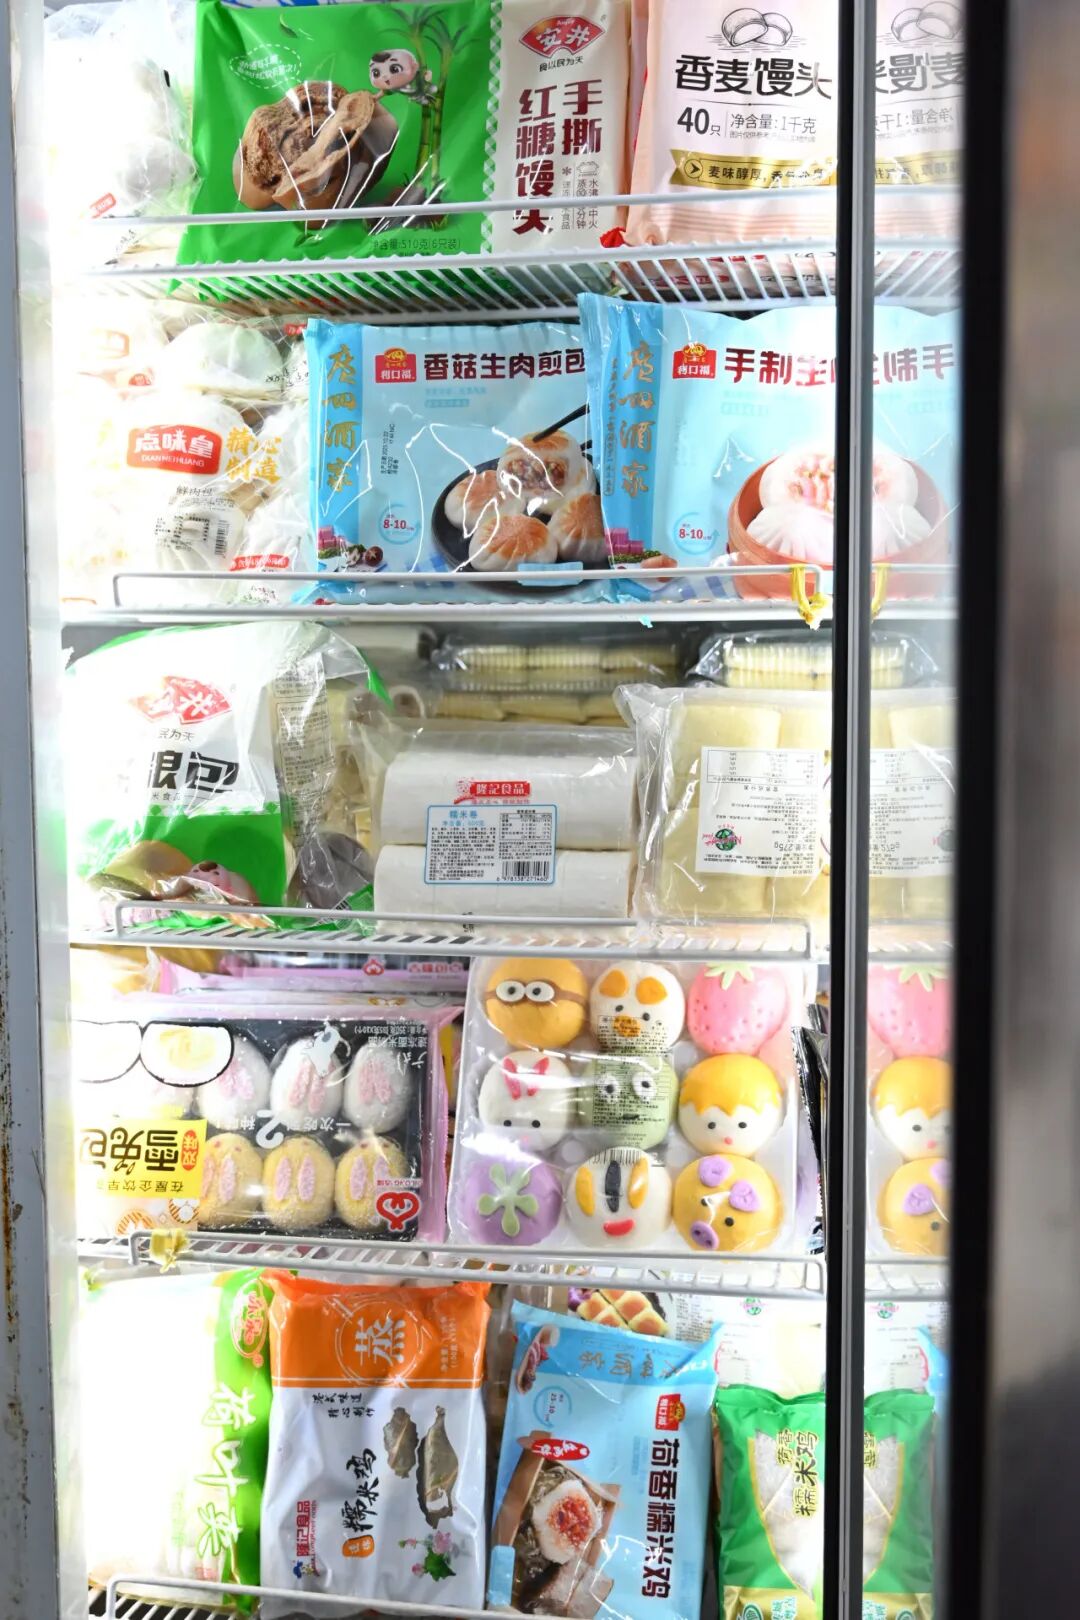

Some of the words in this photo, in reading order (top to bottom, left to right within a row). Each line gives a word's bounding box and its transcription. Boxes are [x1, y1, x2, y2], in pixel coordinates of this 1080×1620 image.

[535, 24, 590, 51] 安井
[540, 56, 584, 72] 食以民为天
[675, 54, 833, 100] 香麦馒头
[561, 79, 603, 155] 手撕
[730, 113, 817, 134] 净含量:1千克
[588, 178, 599, 229] 水沸中火
[424, 348, 586, 381] 香菇生肉煎包
[134, 429, 214, 459] 点味皇
[383, 519, 407, 530] 8-10
[679, 528, 704, 540] 8-10
[183, 1132, 198, 1168] 双味
[355, 1313, 406, 1366] 蒸
[777, 1428, 793, 1466] 荷香
[342, 1447, 380, 1532] 糯米鸡
[793, 1431, 818, 1518] 糯米鸡
[641, 1437, 681, 1599] 荷香糯米鸡
